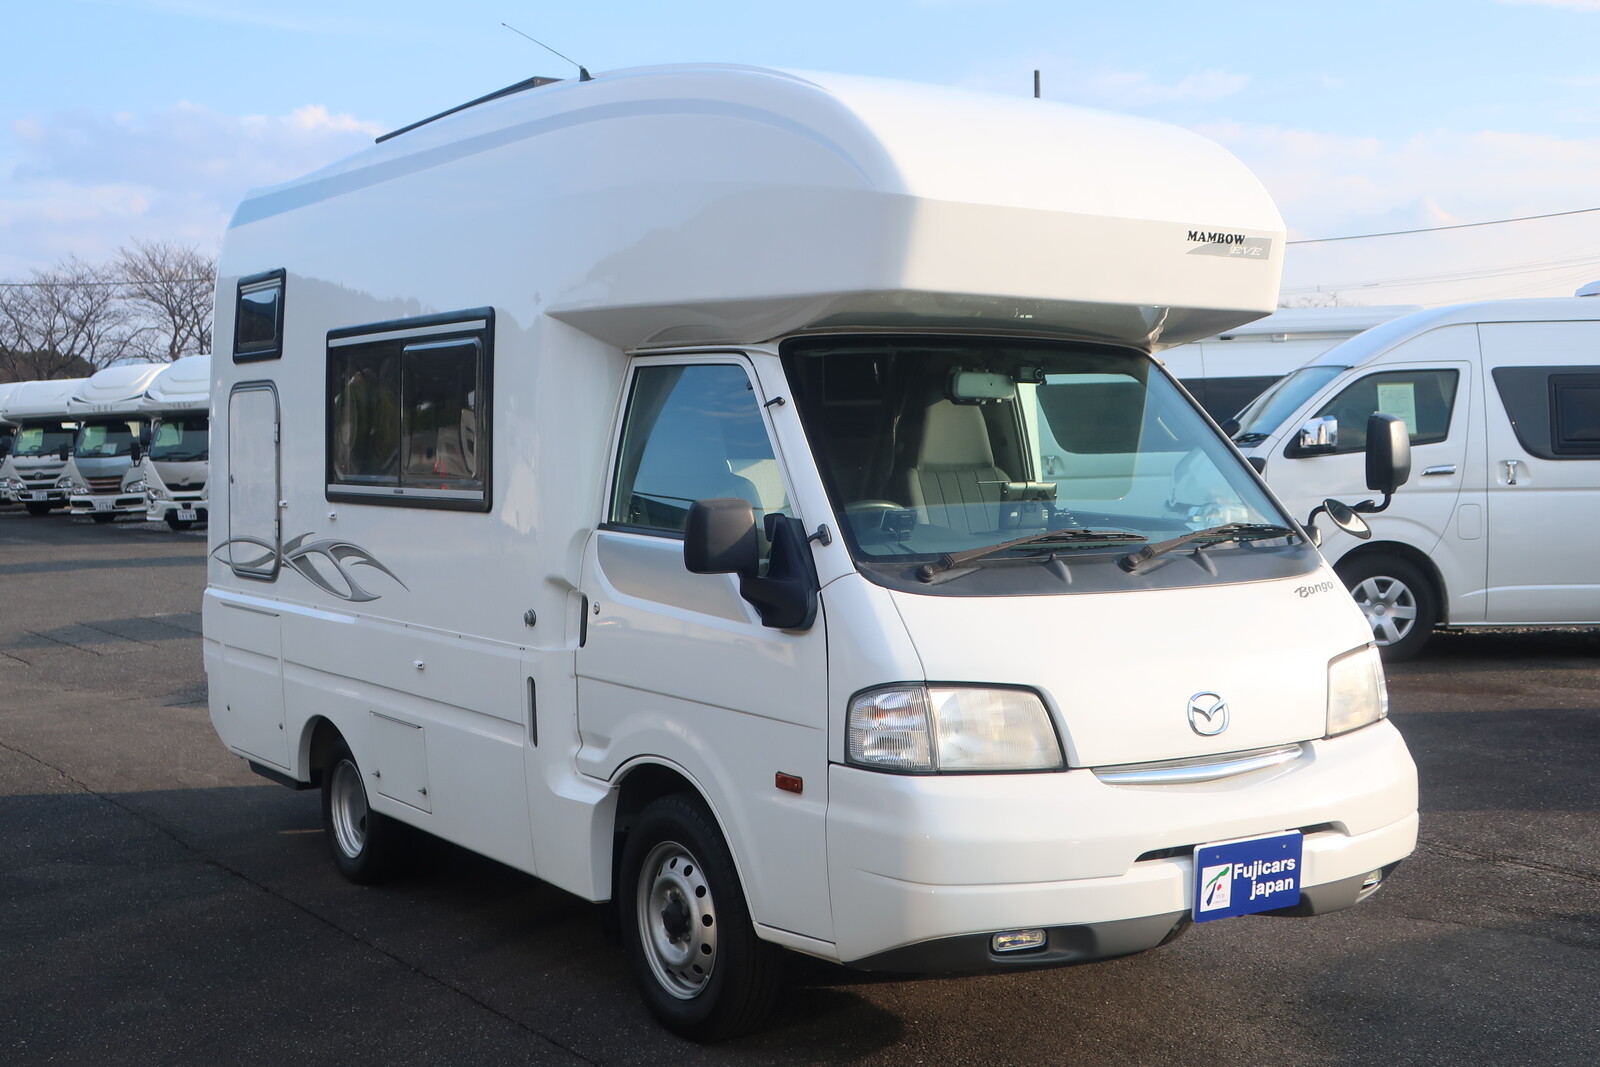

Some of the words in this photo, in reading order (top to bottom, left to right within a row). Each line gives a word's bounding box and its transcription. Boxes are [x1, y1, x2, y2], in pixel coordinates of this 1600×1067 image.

[1187, 231, 1245, 245] MAMBOW
[1230, 246, 1262, 255] EVE
[1294, 581, 1333, 598] Bongo
[1233, 858, 1296, 879] Fujicars
[1250, 877, 1294, 900] japan
